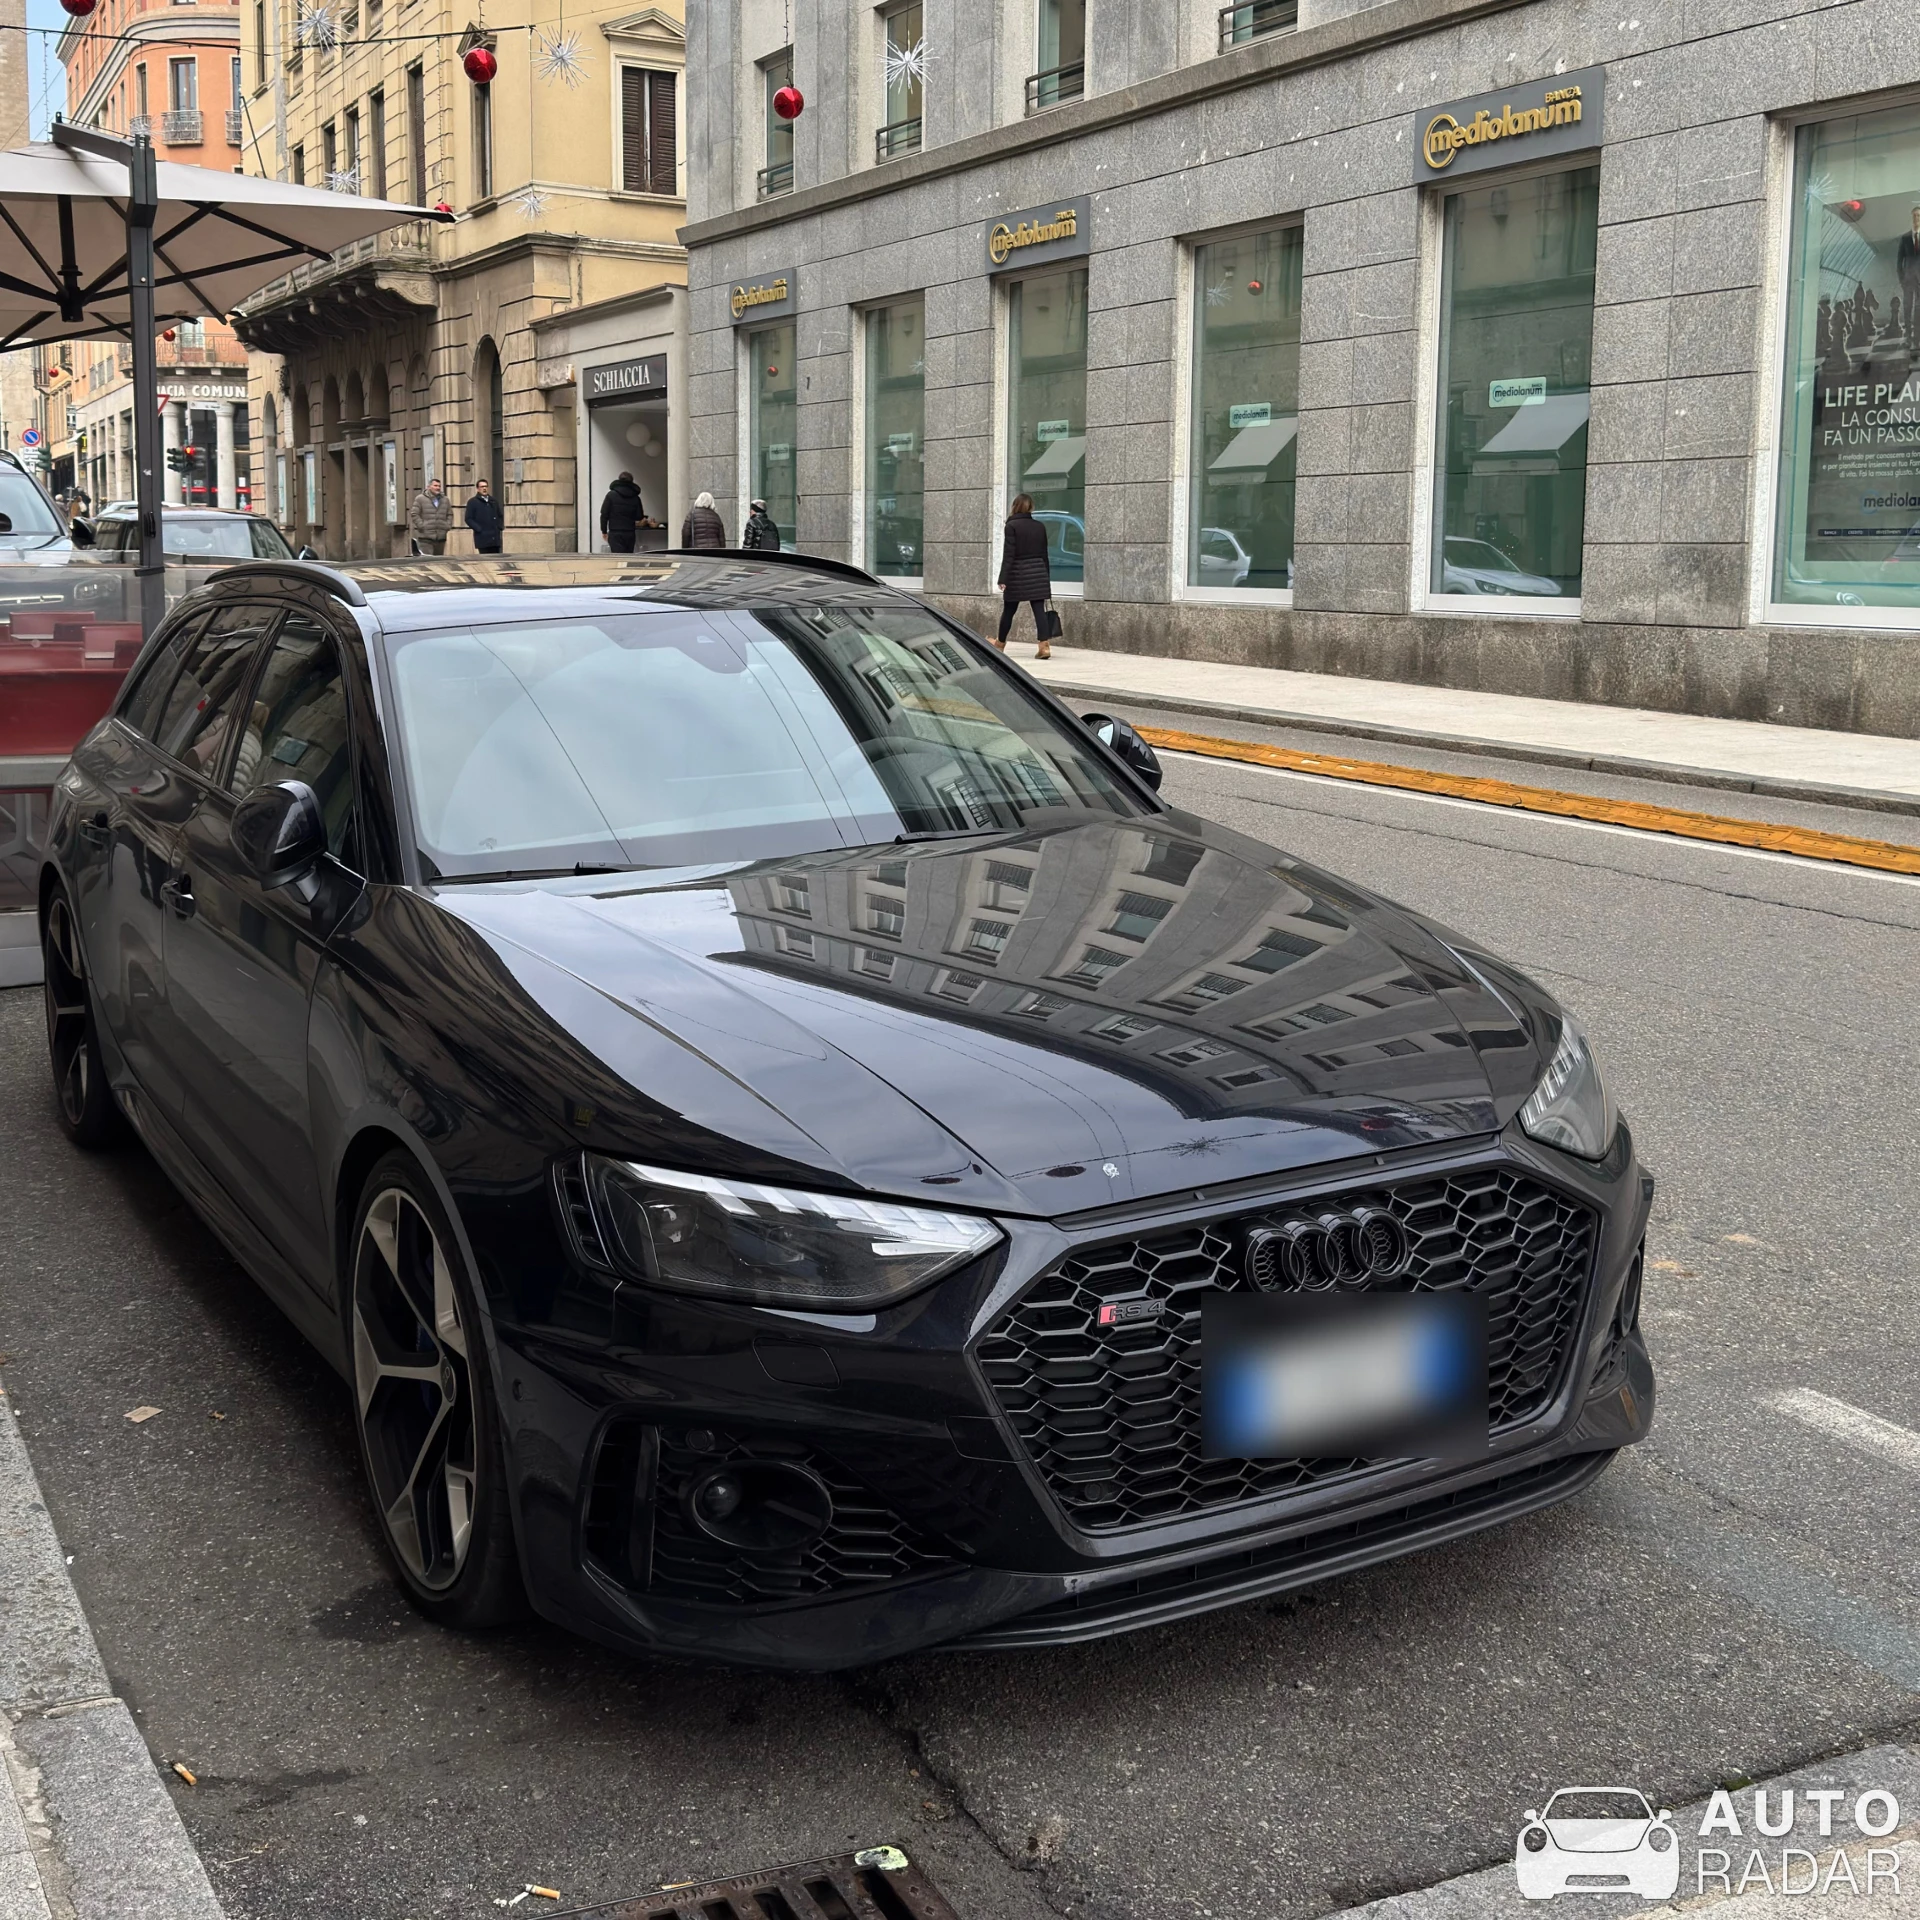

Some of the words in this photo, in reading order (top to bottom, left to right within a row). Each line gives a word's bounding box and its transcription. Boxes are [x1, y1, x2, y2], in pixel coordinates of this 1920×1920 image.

[1545, 86, 1582, 103] BANCA
[1429, 100, 1582, 153] mediolanum
[994, 220, 1077, 252] mediolanum
[593, 364, 651, 393] SCHIACCIA
[192, 384, 249, 399] COMUN
[1494, 385, 1543, 398] mediolanum
[1825, 385, 1868, 408] LIFE
[1841, 411, 1860, 428] LA
[1824, 430, 1844, 446] FA
[1848, 427, 1872, 445] UN
[1109, 1304, 1142, 1322] RS
[1147, 1301, 1163, 1314] 4
